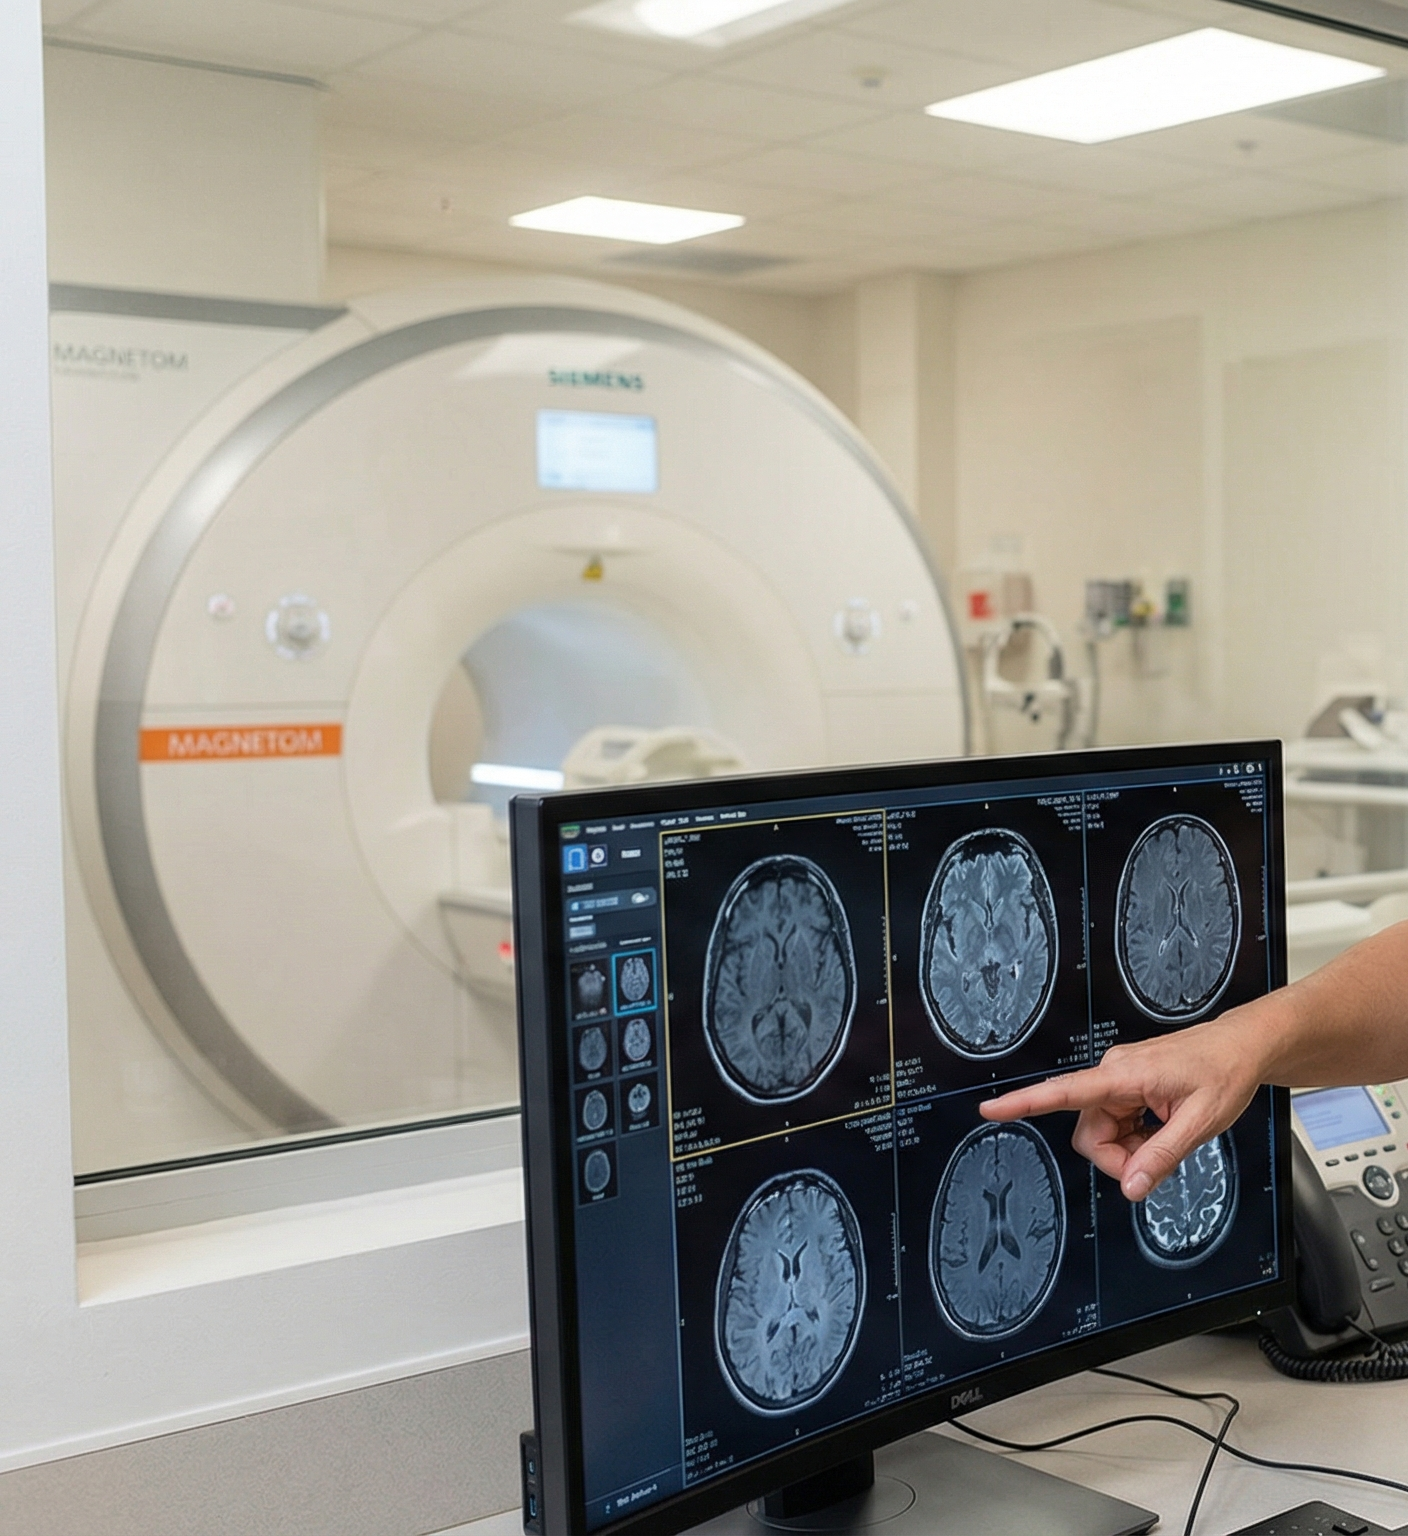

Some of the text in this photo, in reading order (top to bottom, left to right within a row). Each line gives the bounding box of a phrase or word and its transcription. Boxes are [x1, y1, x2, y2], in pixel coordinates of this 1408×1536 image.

[53, 343, 189, 372] MAGNETOM
[548, 369, 644, 391] SIEMENS
[167, 728, 323, 758] MAGNETOM
